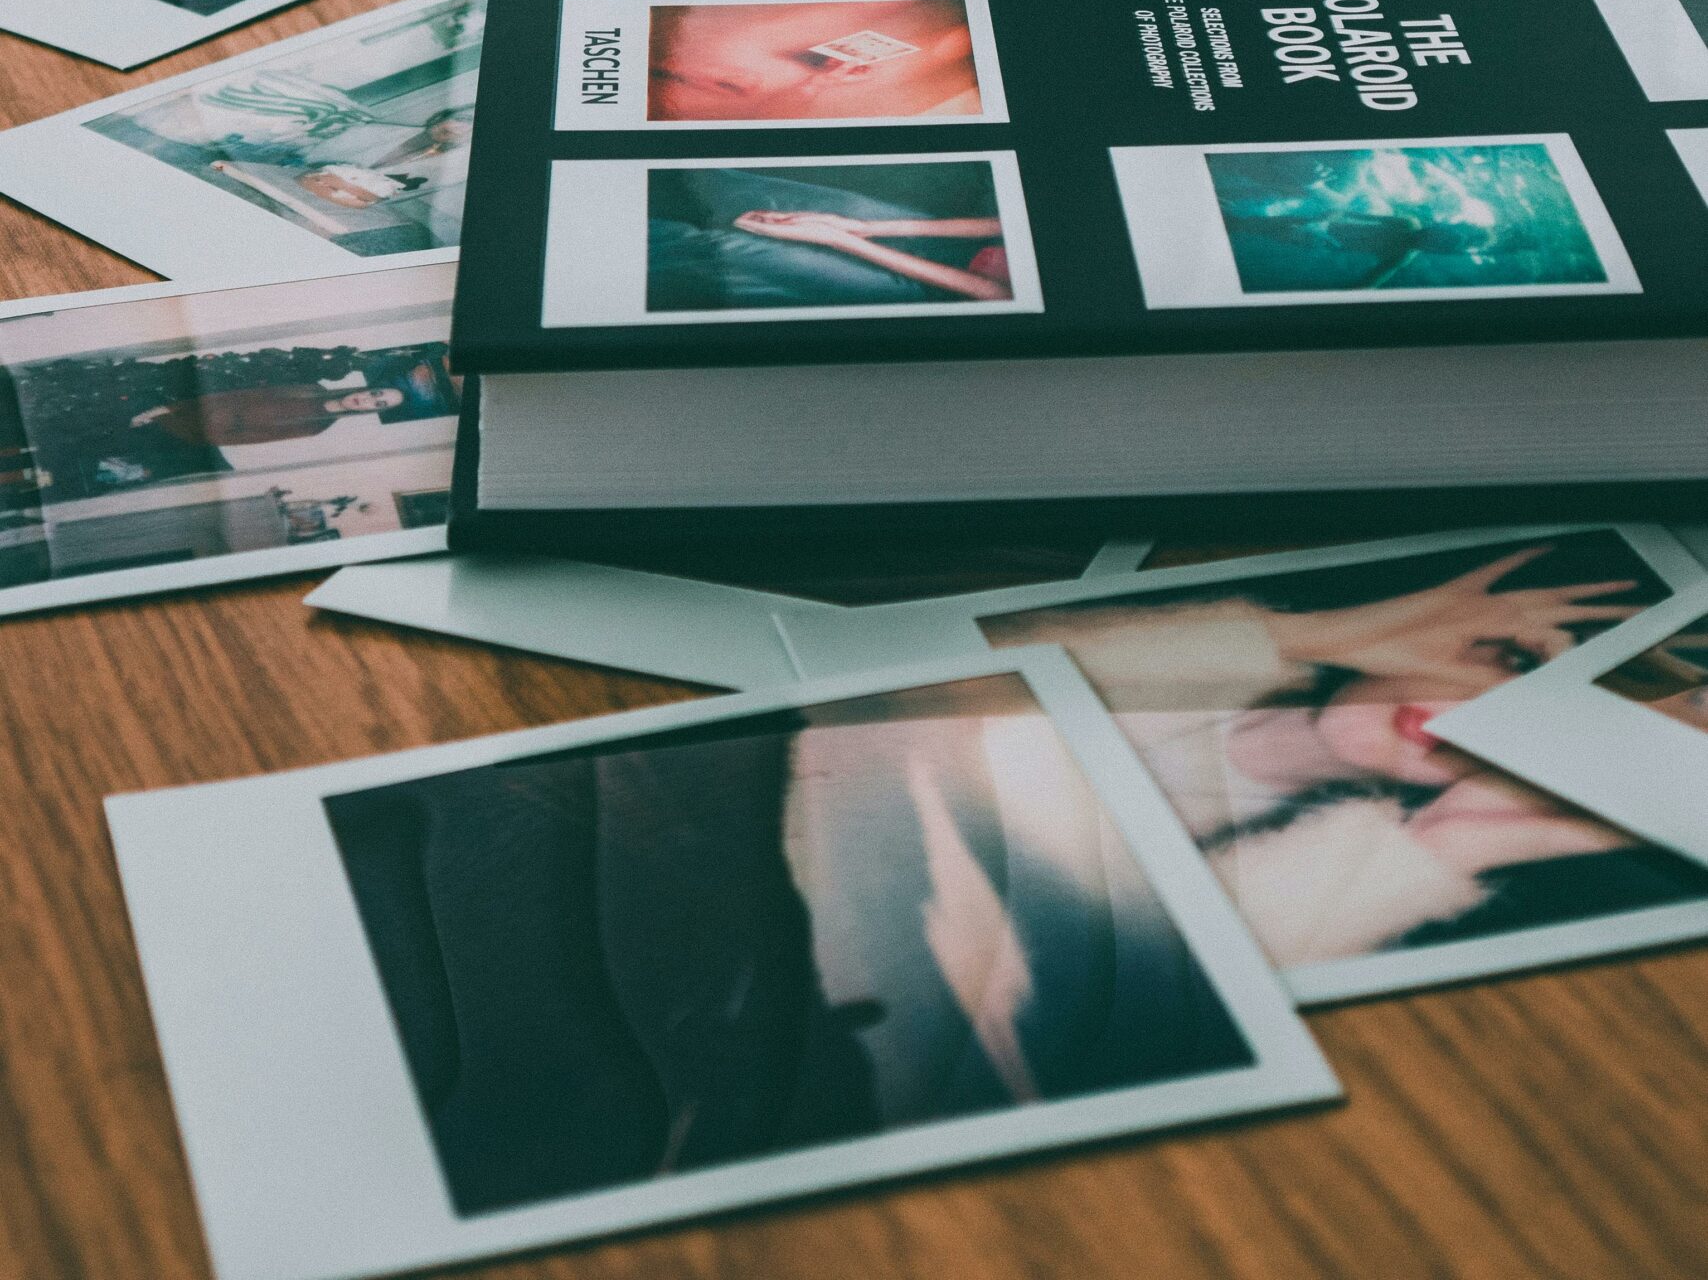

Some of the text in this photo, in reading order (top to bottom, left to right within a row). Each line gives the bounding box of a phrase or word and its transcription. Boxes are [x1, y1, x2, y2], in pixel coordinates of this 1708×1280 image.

[1134, 10, 1174, 89] OF PHOTOGRAPHY
[1166, 5, 1197, 49] POLAROID
[1200, 7, 1243, 88] SELECTIONS FROM
[1260, 7, 1341, 84] BOOK
[1399, 13, 1472, 67] THE
[581, 27, 621, 105] TASCHEN
[1179, 50, 1216, 111] COLLECTIONS
